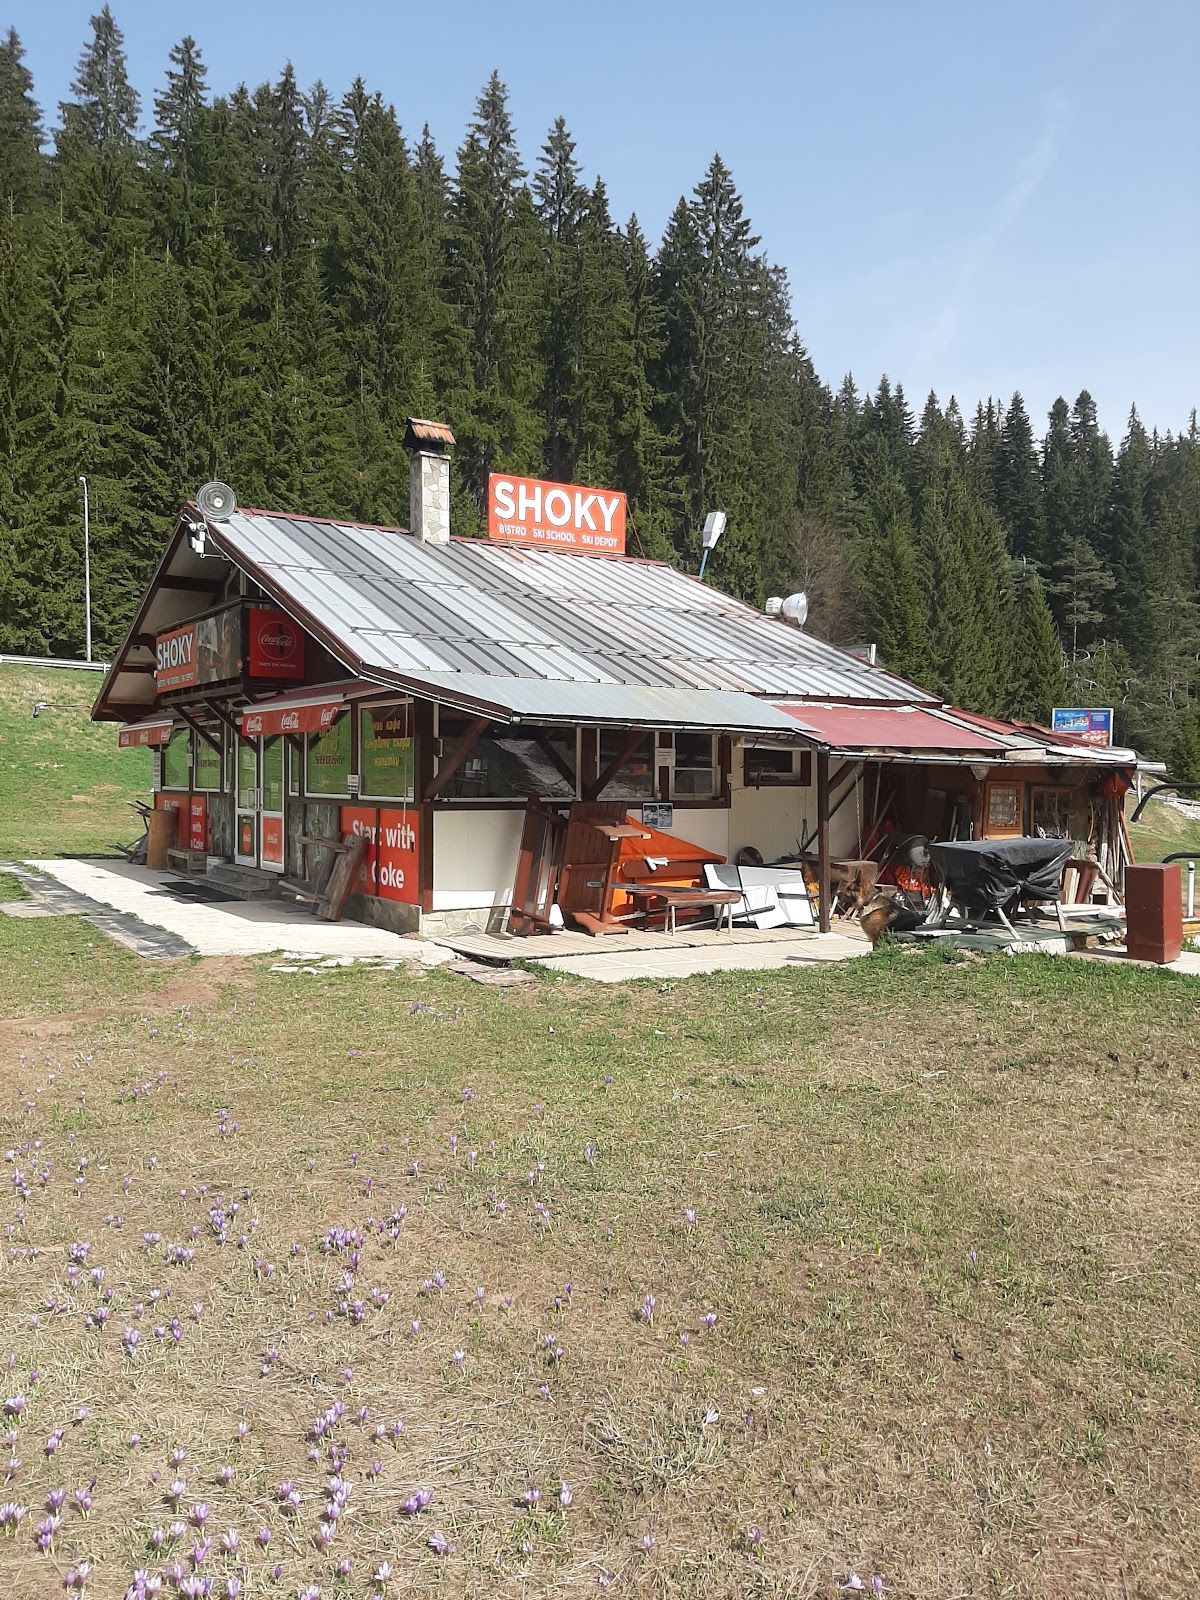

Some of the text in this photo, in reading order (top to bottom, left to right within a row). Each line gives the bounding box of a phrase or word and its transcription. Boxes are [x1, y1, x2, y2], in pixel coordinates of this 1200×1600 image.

[494, 481, 621, 532] SHOKY
[499, 524, 618, 547] BISTRO SKI SCHOOL SKI DEPOT
[157, 633, 193, 671] SHOKY
[386, 823, 416, 851] with
